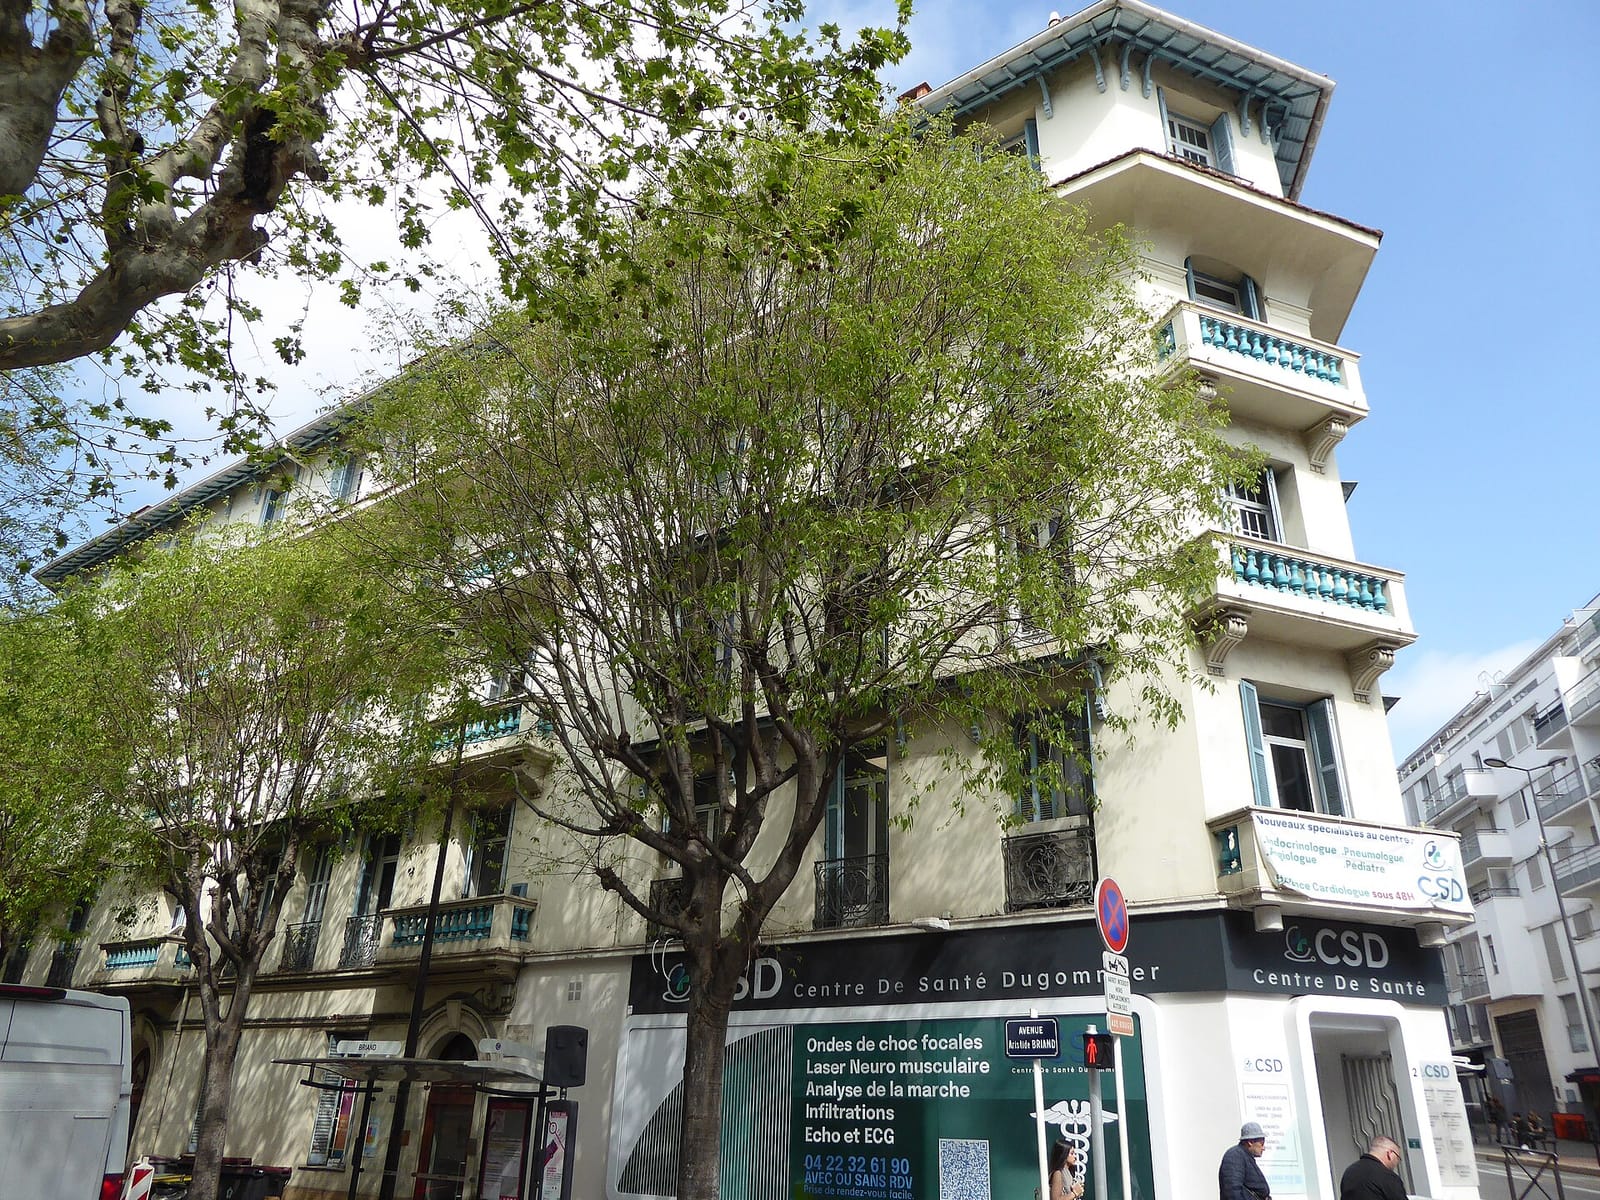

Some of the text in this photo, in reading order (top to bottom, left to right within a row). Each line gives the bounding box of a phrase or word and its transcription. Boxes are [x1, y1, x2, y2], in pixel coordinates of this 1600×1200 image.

[1256, 815, 1305, 830] Nouveaux
[1366, 832, 1378, 840] au
[1312, 882, 1370, 898] Cardiologue
[1372, 891, 1394, 900] sous
[1395, 891, 1415, 901] 48H
[1417, 876, 1463, 902] CSD
[1315, 928, 1389, 968] CSD
[794, 981, 865, 998] Centre
[878, 978, 904, 994] De
[918, 972, 987, 992] Santé
[1253, 968, 1426, 996] Centre De Santé
[1019, 1026, 1043, 1035] AVENUE
[358, 1043, 377, 1051] BRIAND
[806, 1033, 983, 1052] Ondes de choc focales
[1031, 1039, 1056, 1049] BRIAND
[806, 1057, 990, 1075] Laser Neuro musculaire
[1255, 1058, 1283, 1073] CSD
[1412, 1067, 1418, 1077] 2
[1425, 1064, 1450, 1079] CSD
[806, 1080, 970, 1101] Analyse de la marche
[805, 1103, 895, 1121] Infiltrations
[805, 1126, 895, 1144] Echo et ECG
[804, 1154, 910, 1175] 04 22 32 61 90
[804, 1172, 913, 1190] AVEC OU SANS RDV
[803, 1185, 823, 1195] Prise
[825, 1185, 835, 1195] de
[836, 1186, 887, 1199] rendez-vous
